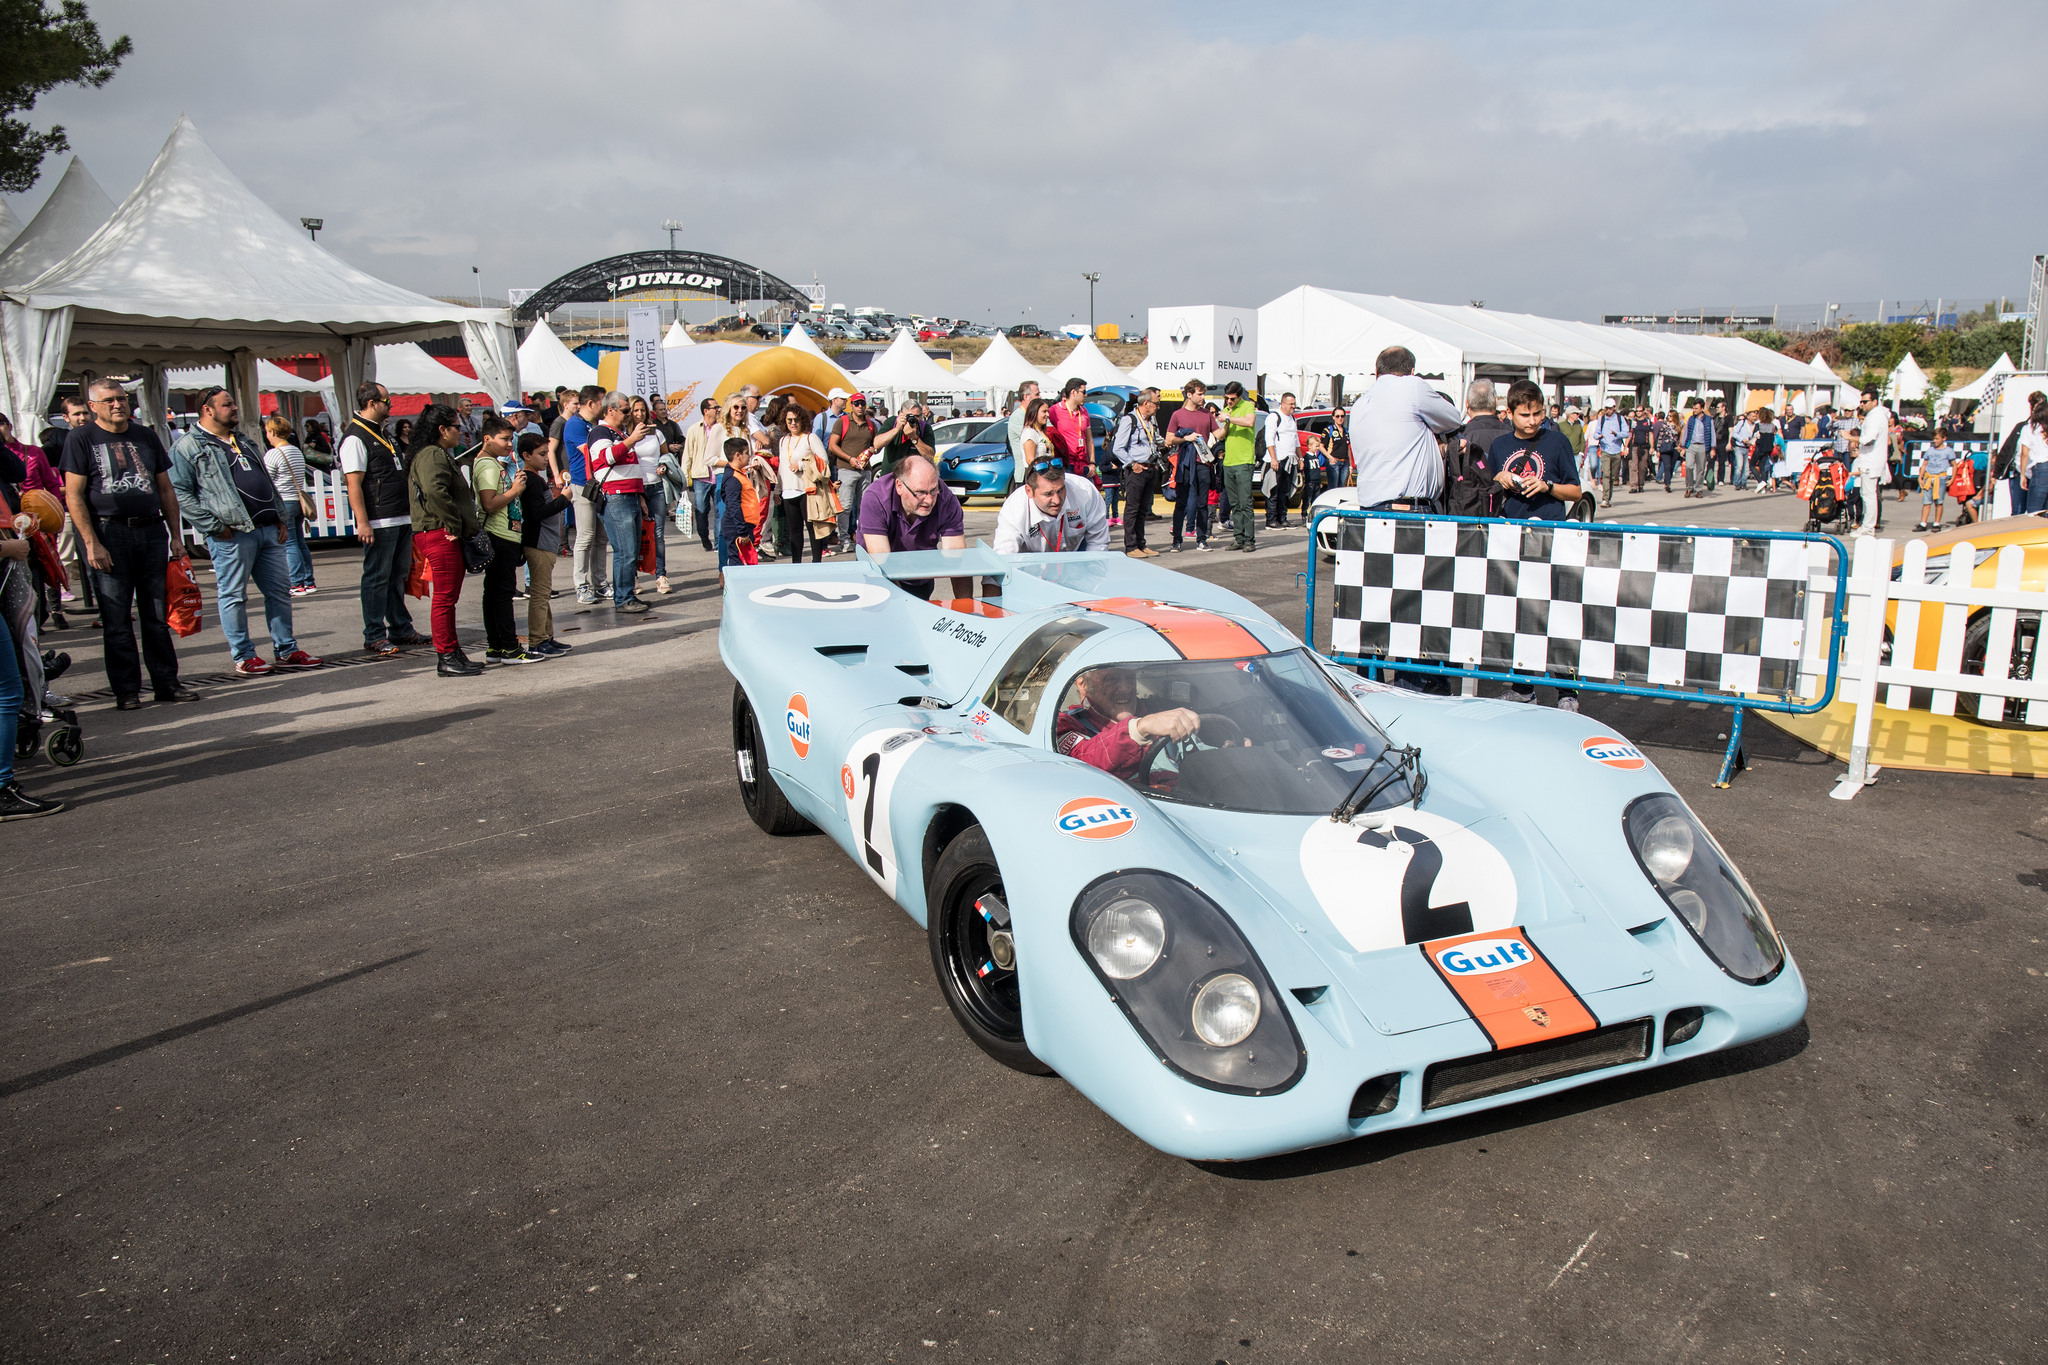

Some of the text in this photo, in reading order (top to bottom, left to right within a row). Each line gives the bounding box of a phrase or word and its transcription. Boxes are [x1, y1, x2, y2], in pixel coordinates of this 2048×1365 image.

[617, 272, 723, 291] DUNLOP
[1156, 361, 1205, 371] RENAULT
[1218, 360, 1253, 371] RENAULT
[932, 617, 955, 633] Gulf
[950, 623, 987, 648] Porsche
[787, 711, 810, 741] Gulf
[1585, 747, 1642, 759] Gulf
[1059, 807, 1132, 831] Gulf
[1357, 825, 1474, 945] 2
[1442, 942, 1529, 973] Gulf
